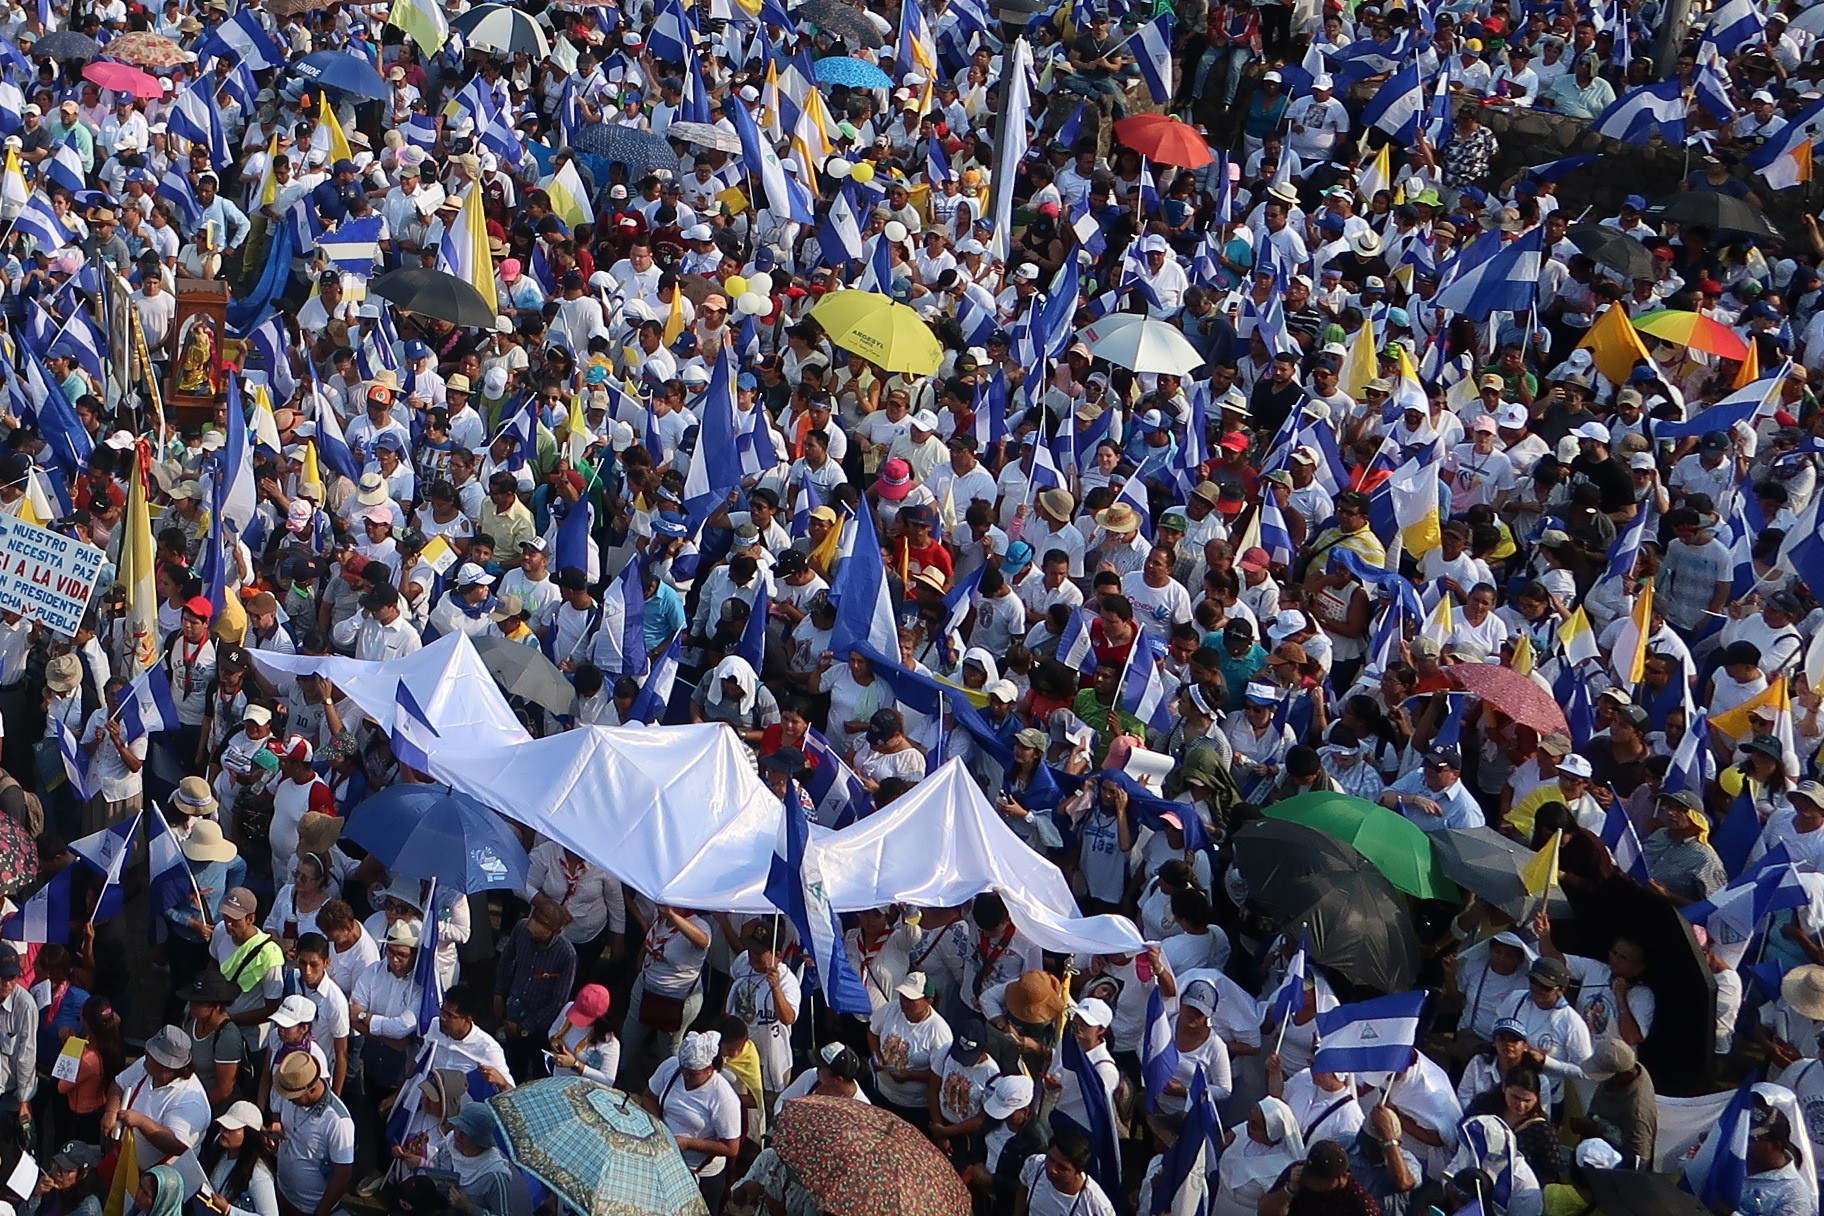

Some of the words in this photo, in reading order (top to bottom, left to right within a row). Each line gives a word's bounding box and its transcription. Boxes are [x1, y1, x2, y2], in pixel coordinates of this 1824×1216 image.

[296, 62, 322, 78] INIDE
[7, 538, 63, 569] NECESITA
[72, 563, 96, 581] PAZ
[12, 523, 68, 553] NUESTRO
[74, 547, 102, 566] PAIS
[14, 559, 26, 577] A
[31, 565, 51, 587] LA
[56, 574, 89, 603] VIDA
[13, 580, 83, 618] PRESIDENTE
[21, 602, 36, 615] AL
[35, 607, 77, 632] PUEBLO
[296, 714, 309, 728] 10
[771, 1025, 780, 1039] 3
[63, 1143, 74, 1153] S
